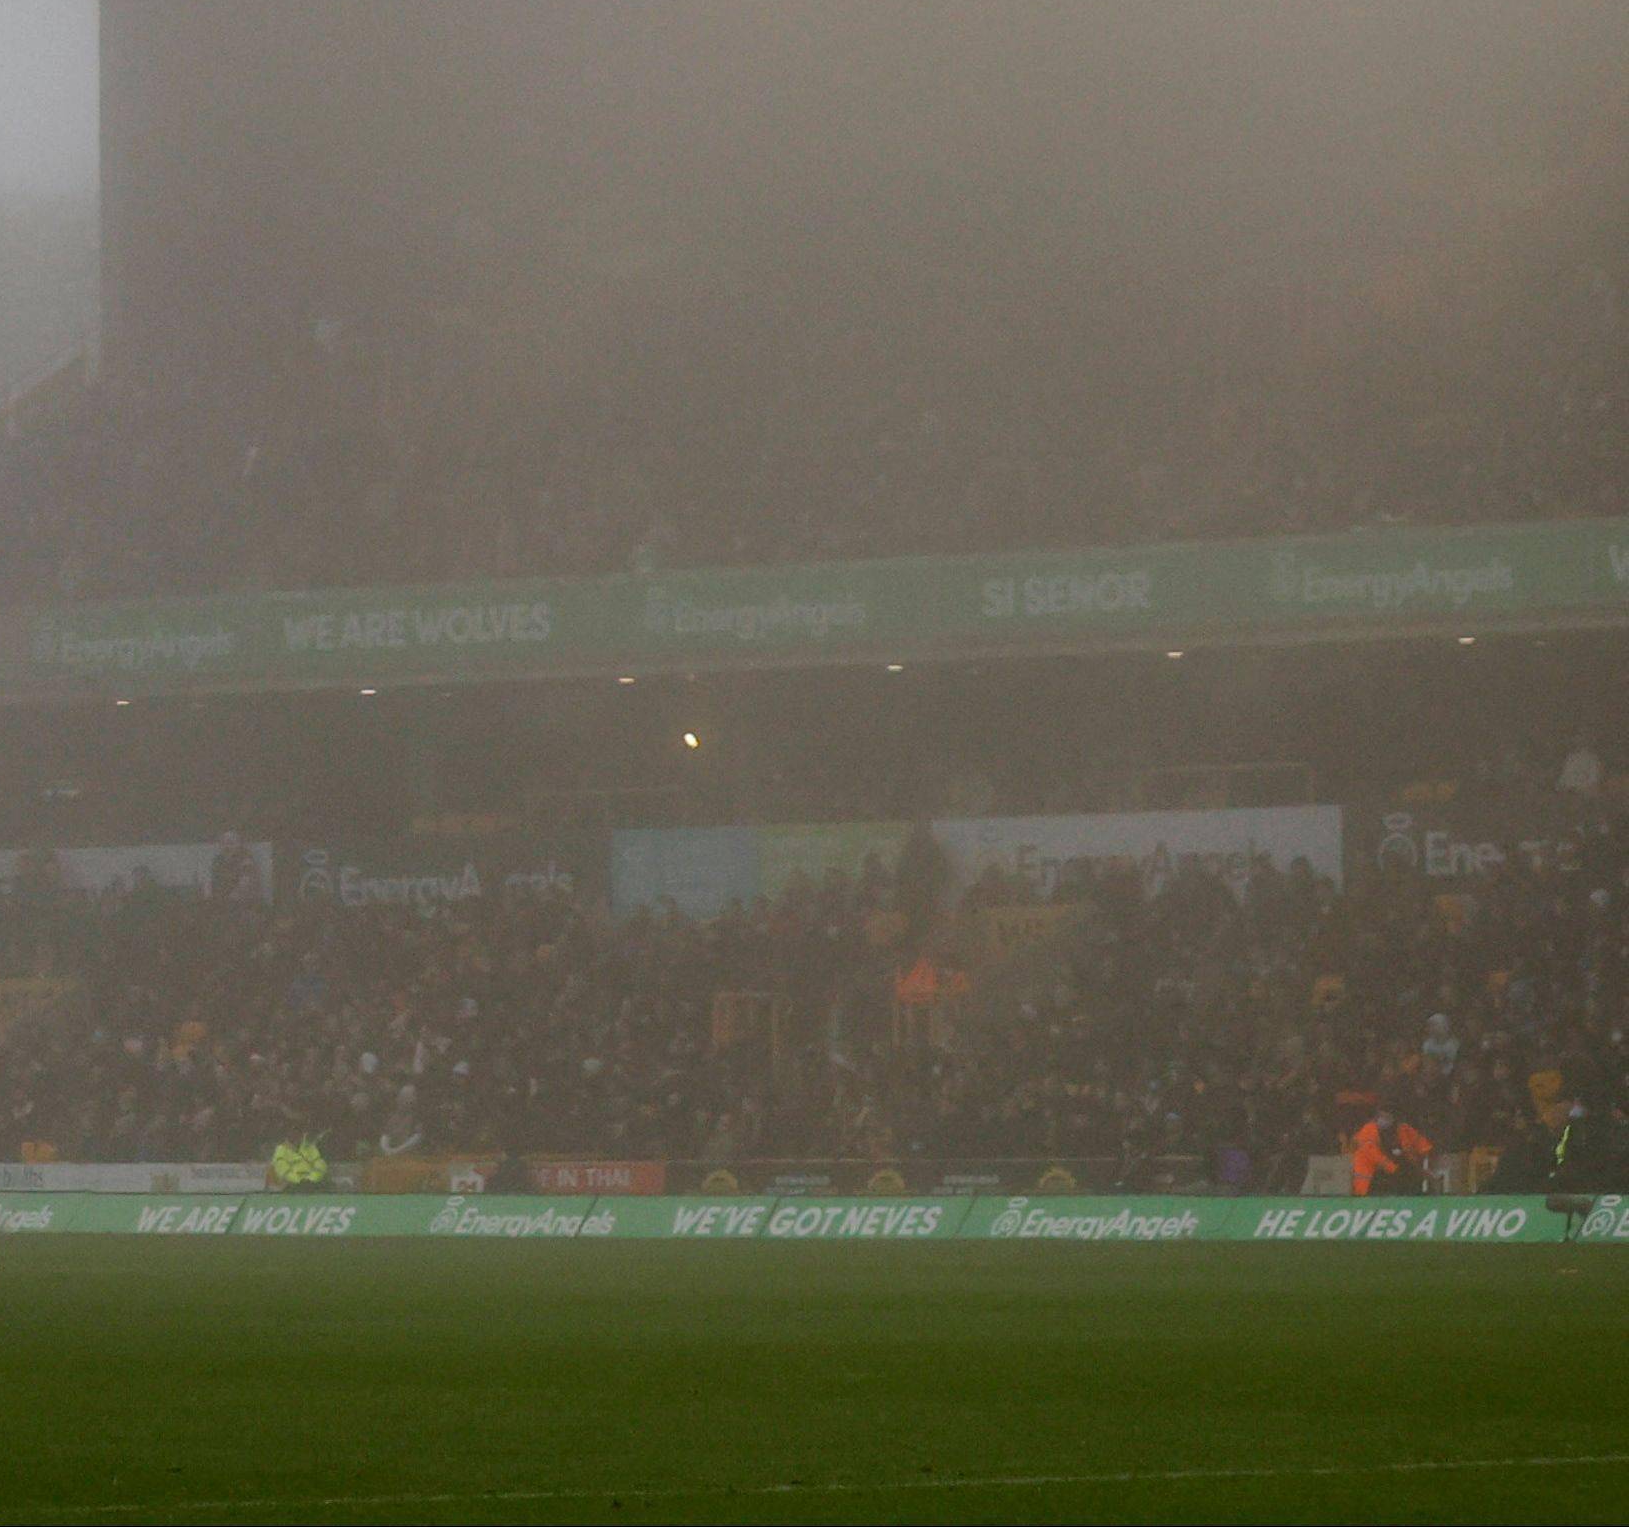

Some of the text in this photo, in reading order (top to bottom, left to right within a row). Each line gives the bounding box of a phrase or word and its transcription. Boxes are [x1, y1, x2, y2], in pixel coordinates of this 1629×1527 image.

[284, 602, 553, 651] WE ARE WOLVES
[137, 1206, 356, 1234] WE ARE WOLVES
[672, 1205, 943, 1237] WE'VE GOT NEVES
[1018, 1207, 1199, 1240] EnergyAngels
[1253, 1209, 1529, 1238] HE LOVES A VINO
